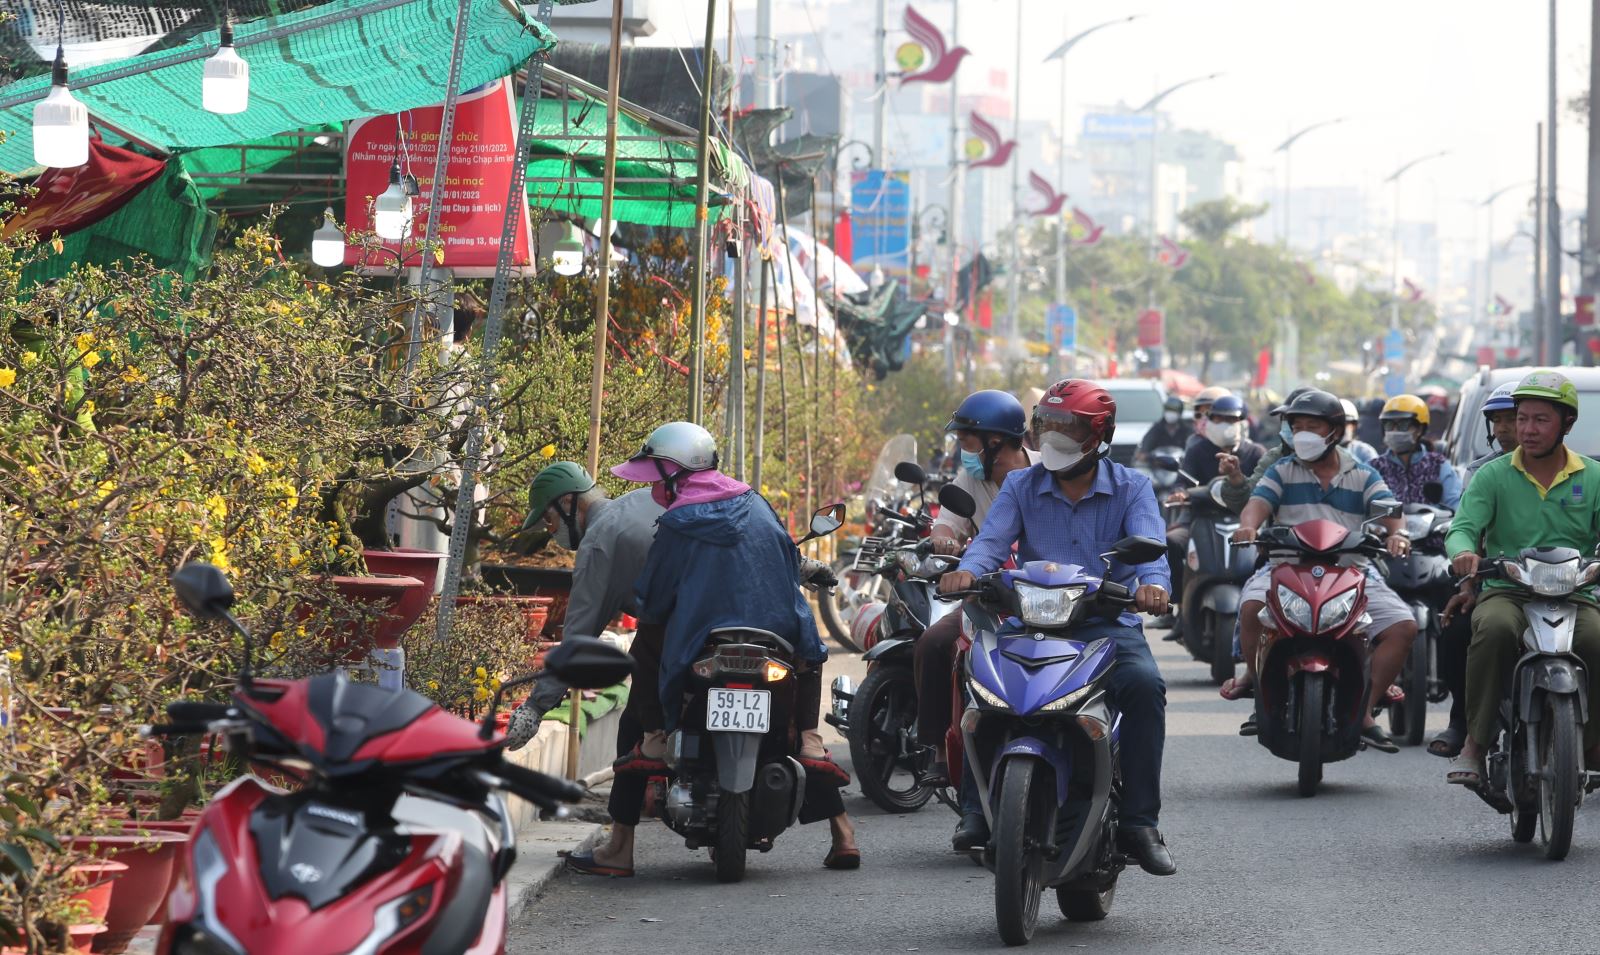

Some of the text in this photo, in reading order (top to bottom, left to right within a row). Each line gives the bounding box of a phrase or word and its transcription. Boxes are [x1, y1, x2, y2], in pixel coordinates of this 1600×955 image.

[398, 143, 436, 152] 0/01/2023
[470, 143, 508, 153] 21/01/2023
[423, 154, 437, 165] ngà
[442, 175, 460, 185] hai
[442, 190, 480, 200] 6/01/2023
[717, 691, 761, 710] 59-L2
[711, 710, 765, 729] 284.04
